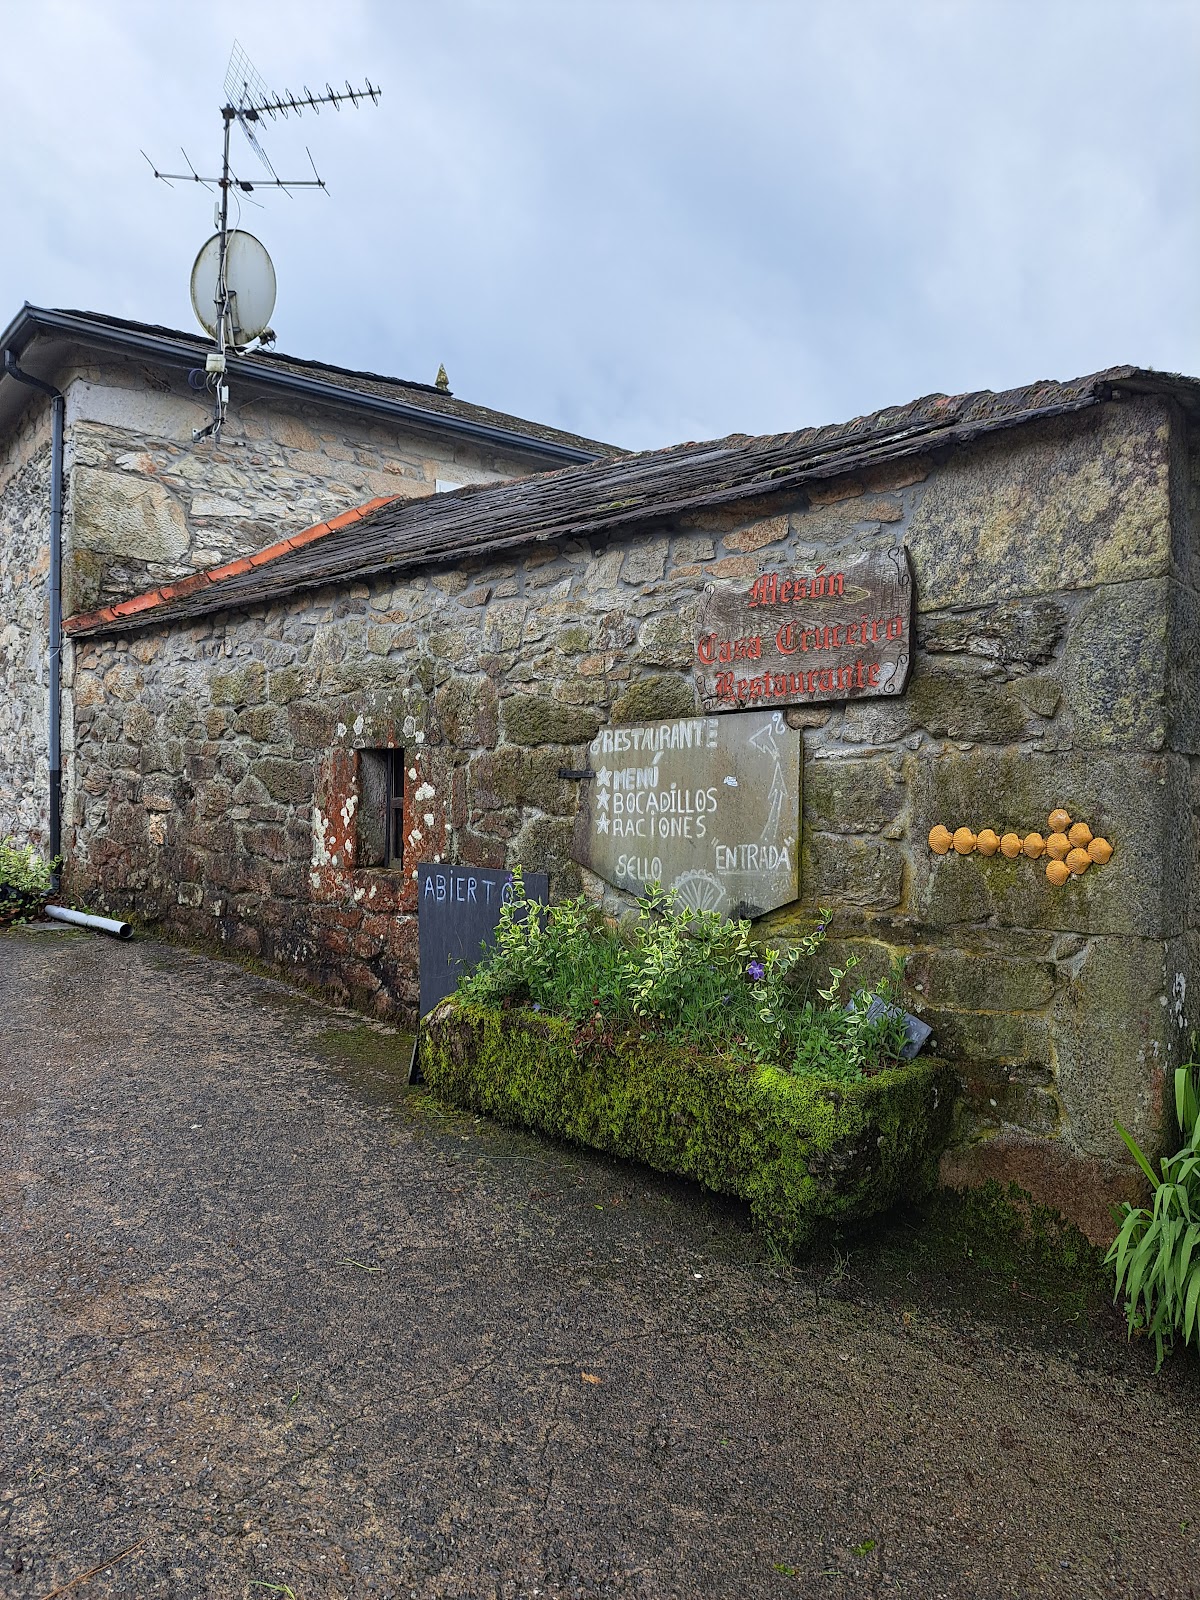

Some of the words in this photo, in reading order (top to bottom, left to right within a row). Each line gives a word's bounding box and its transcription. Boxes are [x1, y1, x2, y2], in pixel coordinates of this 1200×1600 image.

[748, 564, 845, 607] Mesón
[697, 633, 761, 665] Casa
[775, 614, 903, 655] Cruceiro
[715, 659, 881, 702] Restaurante
[613, 751, 664, 790] MENÚ
[615, 854, 662, 880] SELLO
